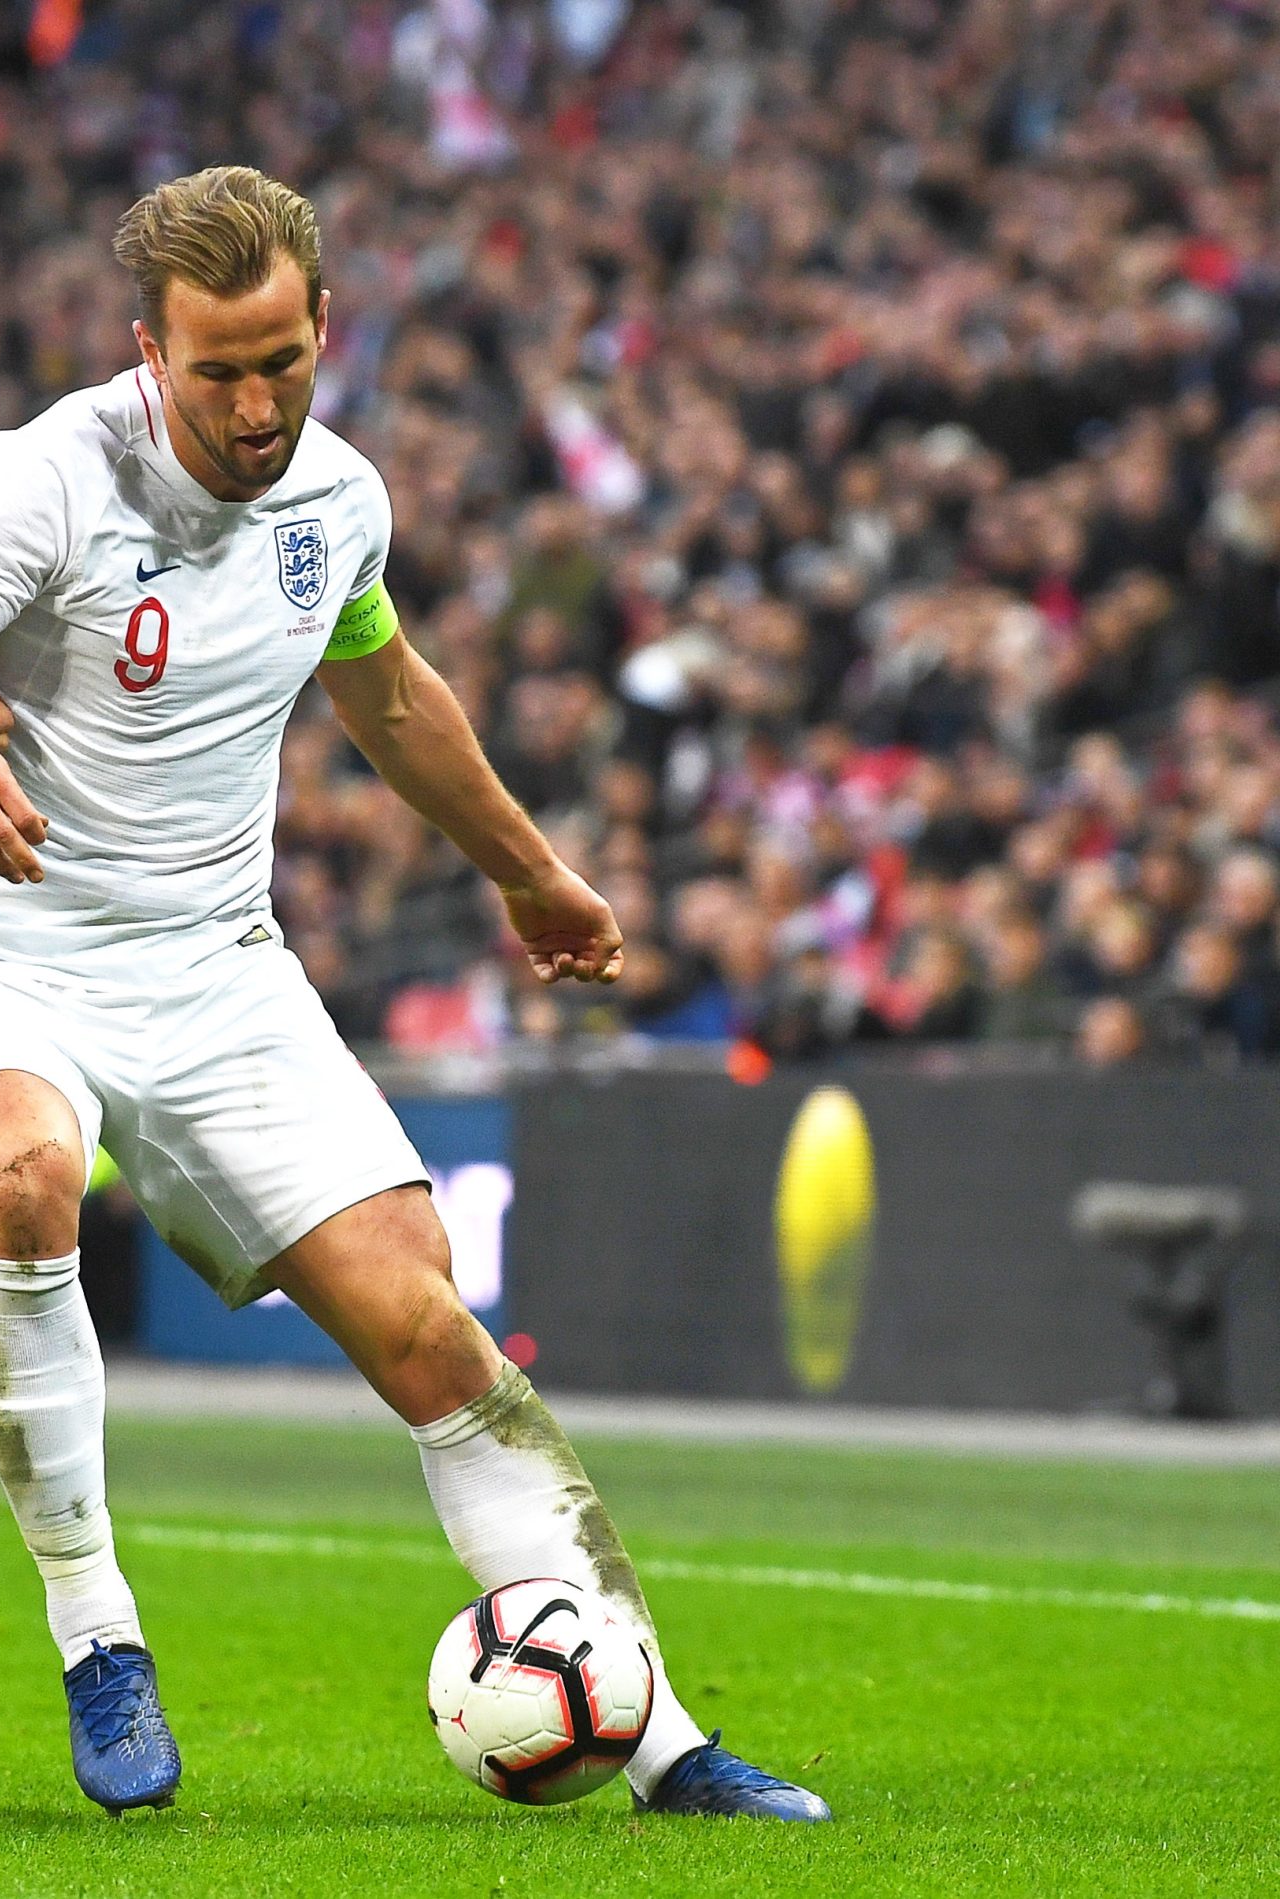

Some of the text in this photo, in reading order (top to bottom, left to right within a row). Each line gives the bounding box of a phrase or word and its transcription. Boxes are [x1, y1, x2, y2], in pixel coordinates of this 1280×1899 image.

[337, 599, 380, 627] ACISM
[114, 597, 169, 693] 9
[331, 622, 377, 646] SPECT
